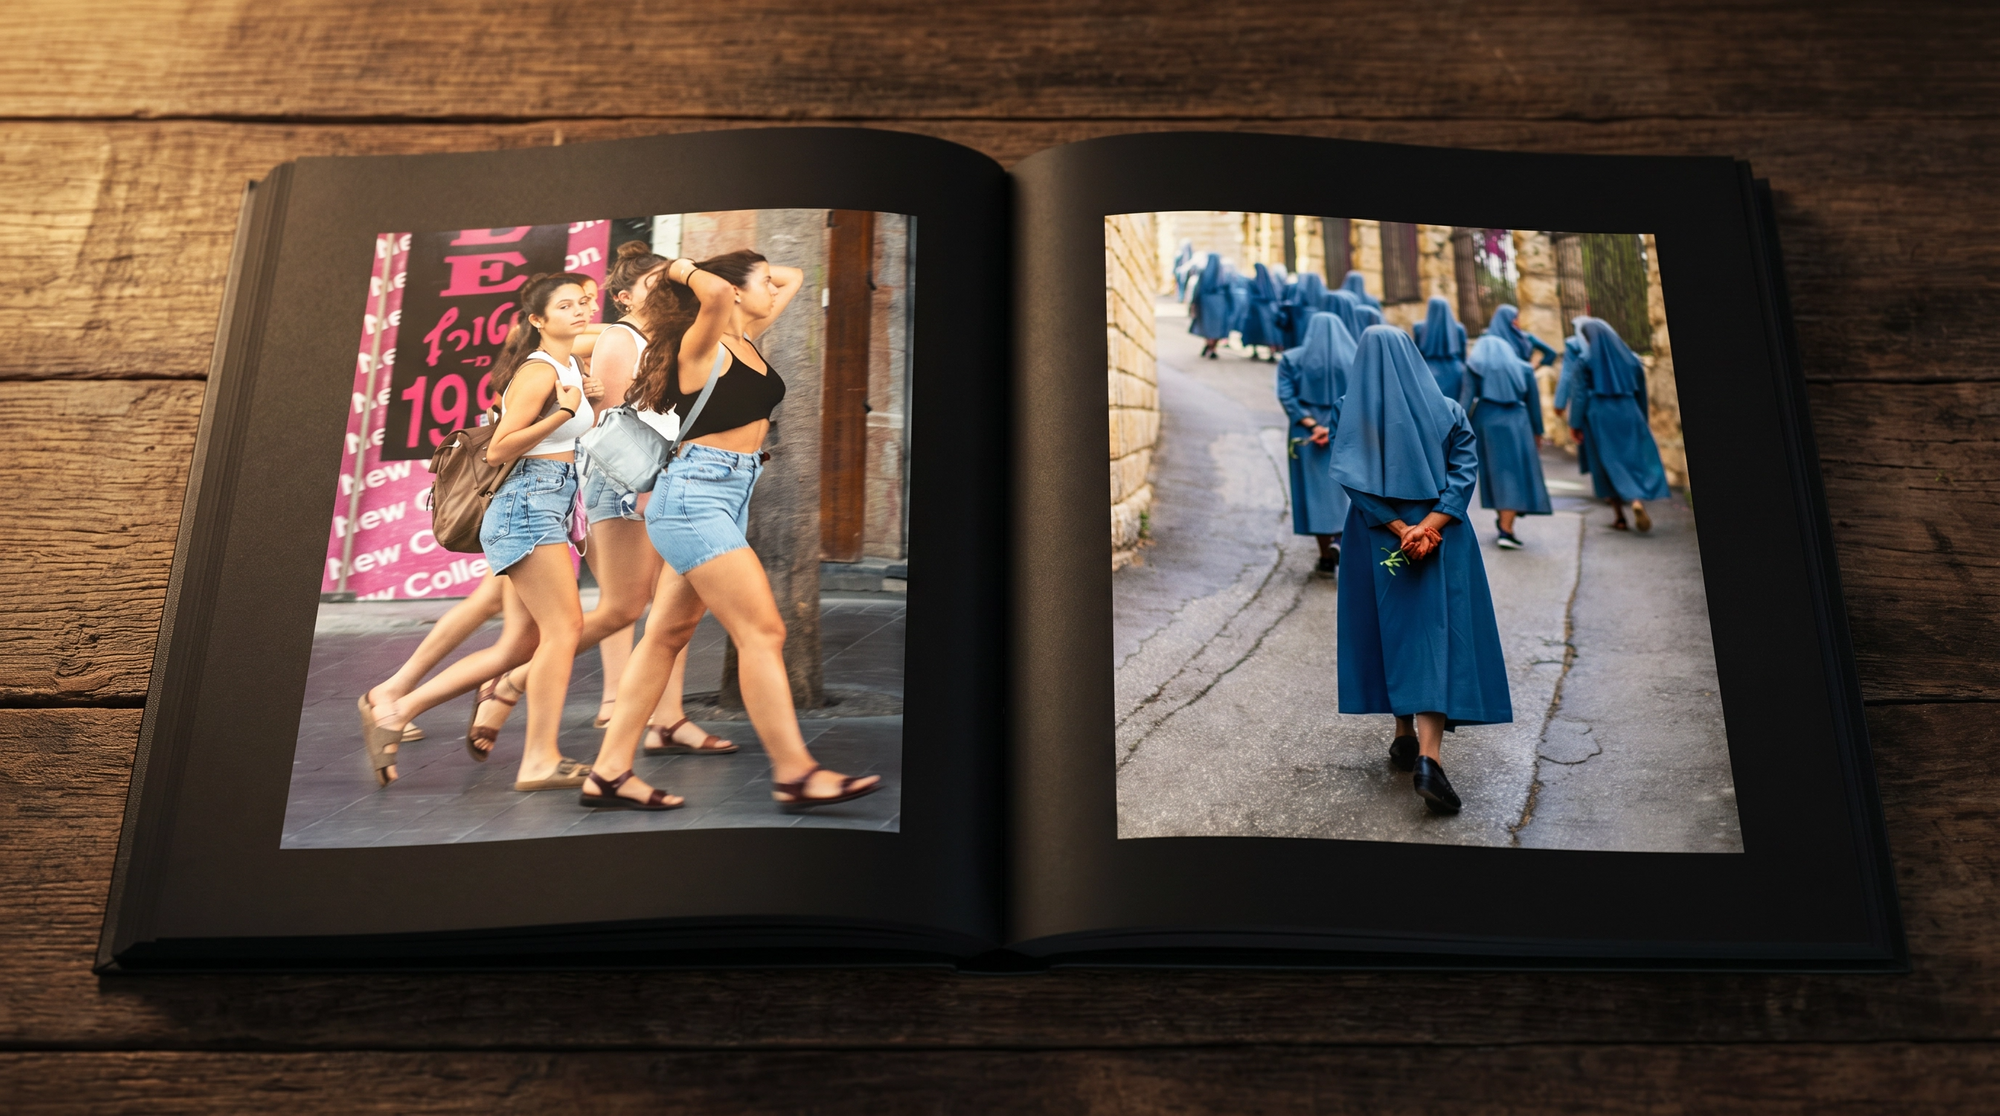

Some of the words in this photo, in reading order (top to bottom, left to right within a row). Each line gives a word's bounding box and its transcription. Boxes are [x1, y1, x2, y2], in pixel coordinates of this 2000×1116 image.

[341, 460, 412, 496] New
[334, 501, 407, 538] New
[327, 543, 401, 581] New
